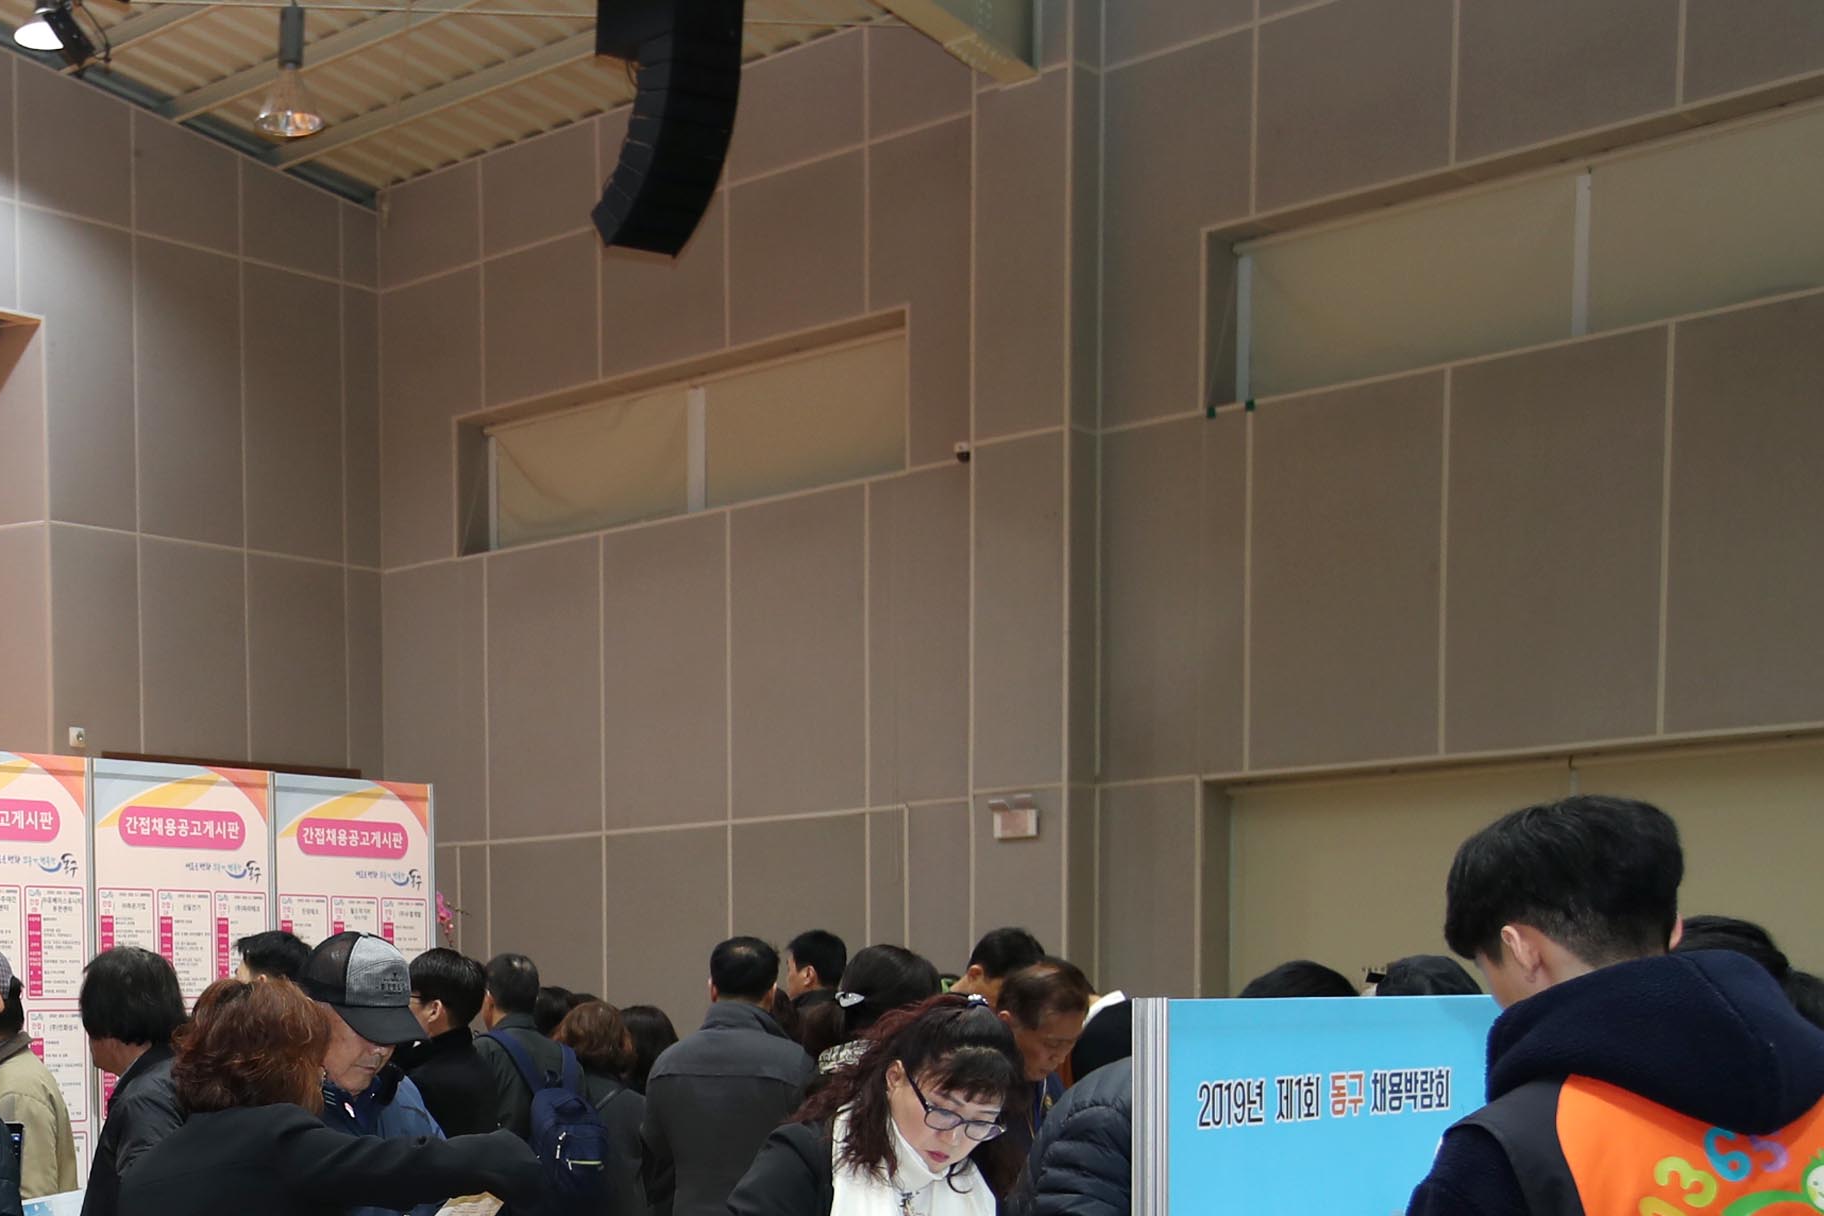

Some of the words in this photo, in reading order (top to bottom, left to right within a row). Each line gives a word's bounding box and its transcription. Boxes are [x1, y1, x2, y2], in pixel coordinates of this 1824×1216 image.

[125, 816, 241, 841] 간접채용공고게시판
[303, 825, 403, 848] 간접채용공고게시판
[1196, 1076, 1266, 1130] 2019년
[1275, 1073, 1321, 1122] 제1회
[1329, 1070, 1366, 1118] 동구
[1371, 1066, 1451, 1114] 채용박람회
